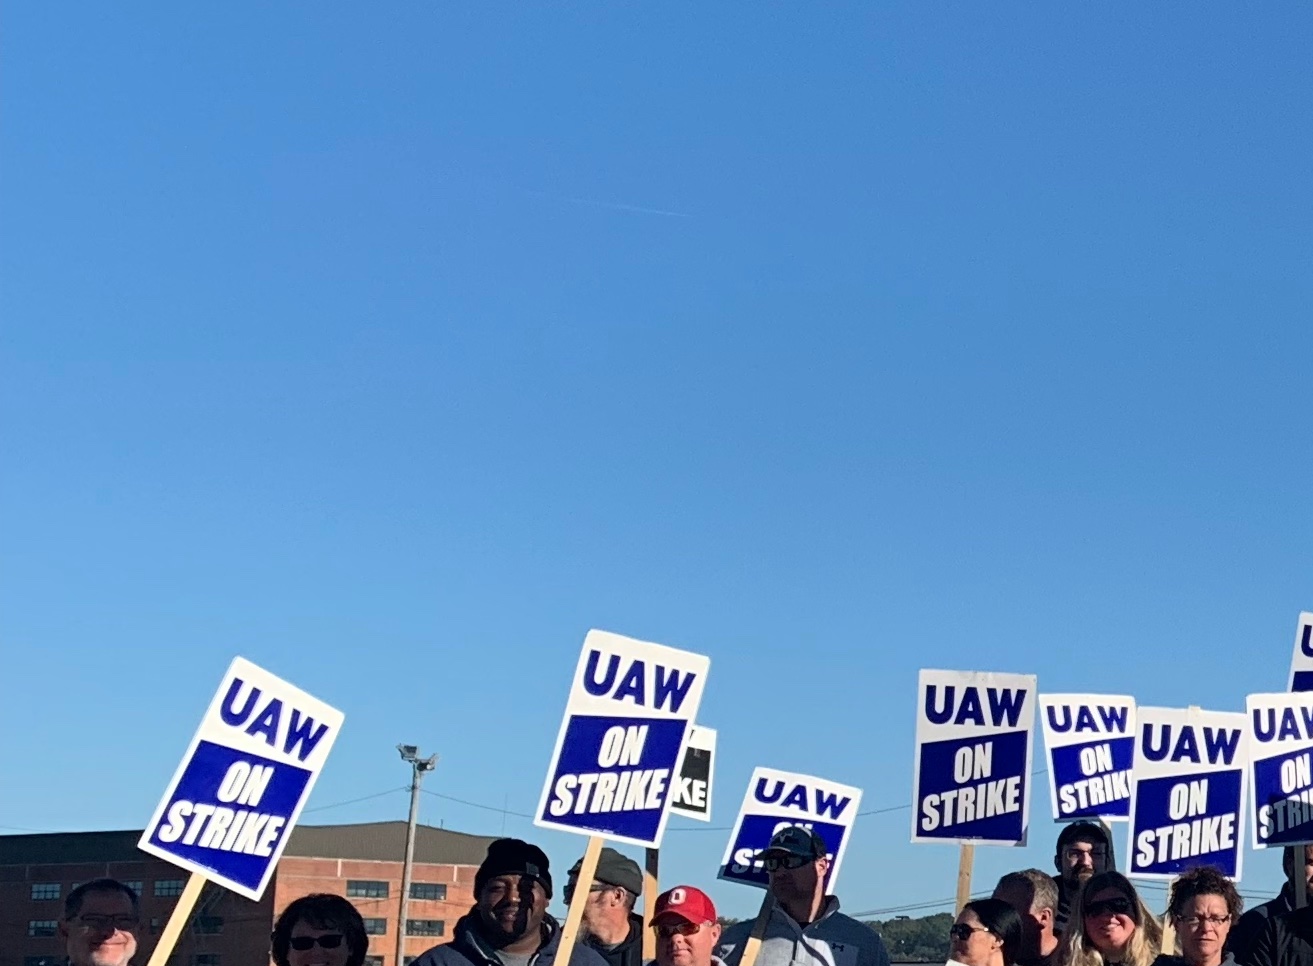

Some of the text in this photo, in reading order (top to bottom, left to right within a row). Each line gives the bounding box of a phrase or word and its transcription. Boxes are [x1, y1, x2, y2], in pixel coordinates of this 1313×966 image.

[582, 648, 696, 713] UAW
[219, 677, 328, 762] UAW
[925, 684, 1026, 729] UAW
[1047, 705, 1128, 734] UAW
[597, 725, 647, 768] ON
[953, 743, 994, 783] ON
[1080, 743, 1113, 776] ON
[1141, 724, 1241, 766] UAW
[216, 760, 272, 807] ON
[549, 764, 670, 817] STRIKE
[1059, 769, 1132, 815] STRIK
[1280, 752, 1311, 793] ON
[755, 777, 851, 820] UAW
[921, 775, 1021, 839] STRIKE
[1168, 779, 1208, 822] ON
[160, 801, 285, 857] STRIKE
[1136, 811, 1236, 868] STRIKE
